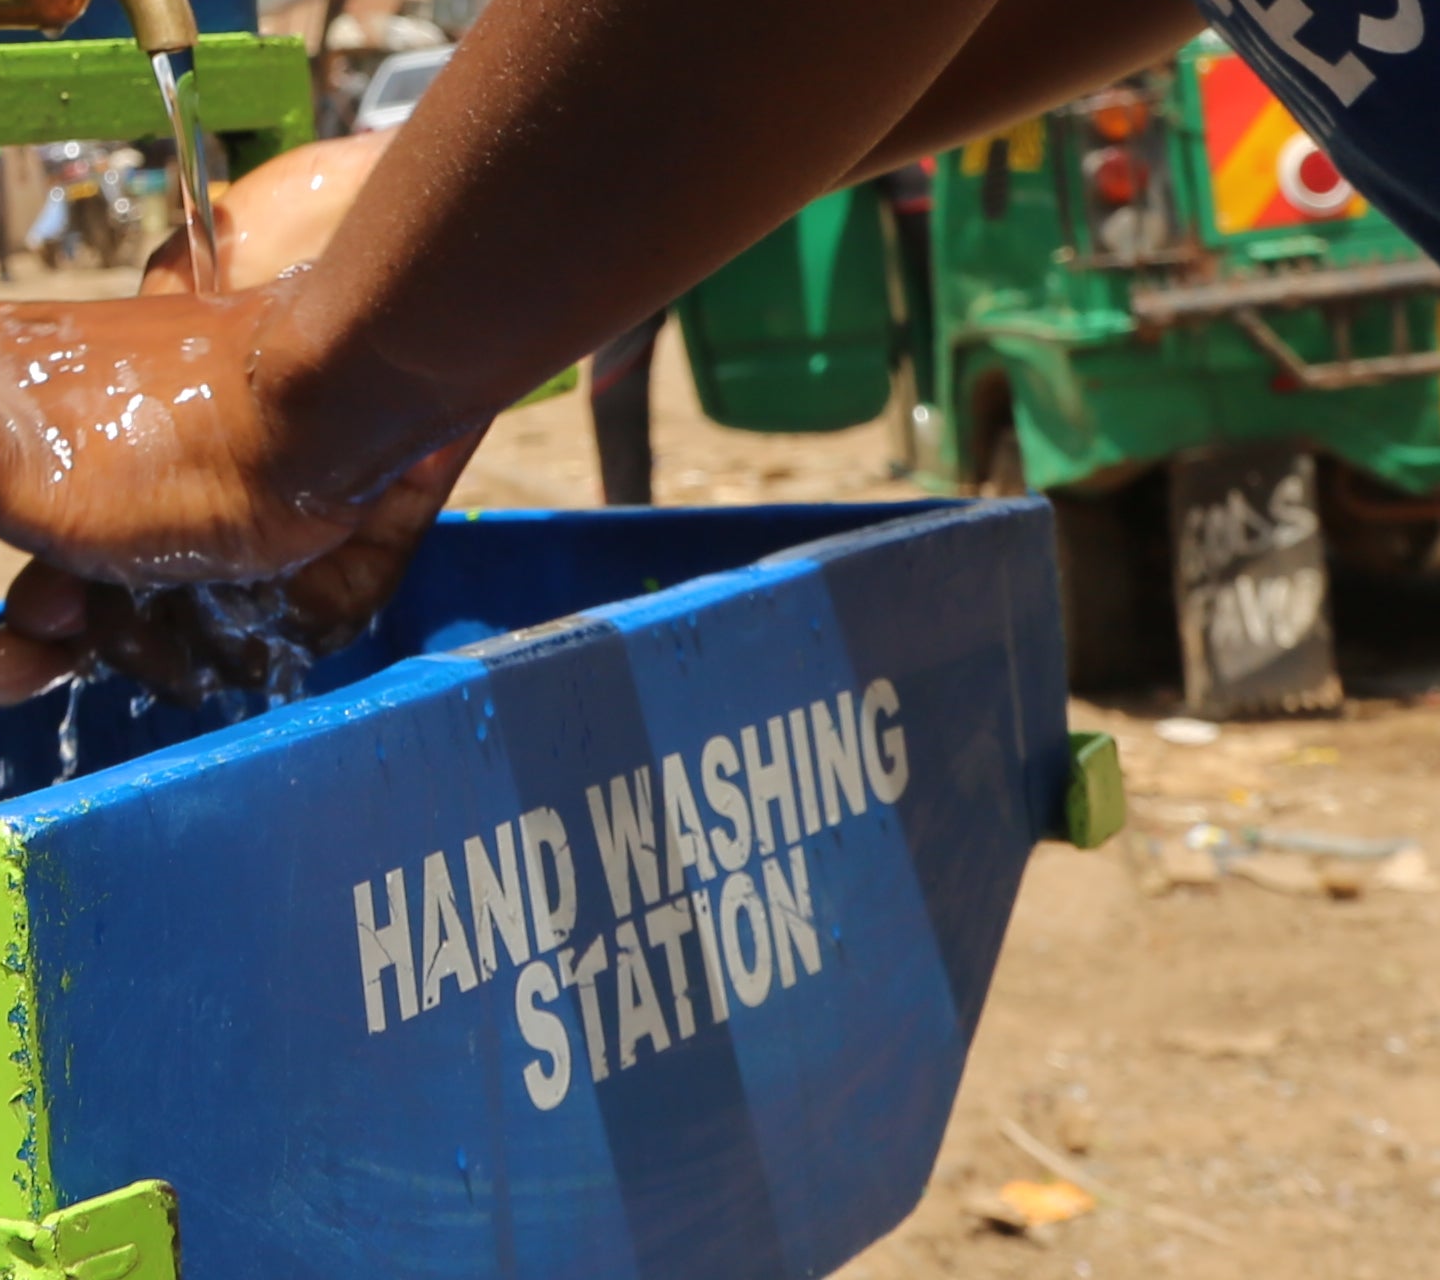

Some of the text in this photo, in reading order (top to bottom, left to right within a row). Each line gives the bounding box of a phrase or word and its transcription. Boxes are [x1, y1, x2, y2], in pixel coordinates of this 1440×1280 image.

[352, 677, 909, 1036] HAND WASHING
[515, 844, 823, 1112] STATION
